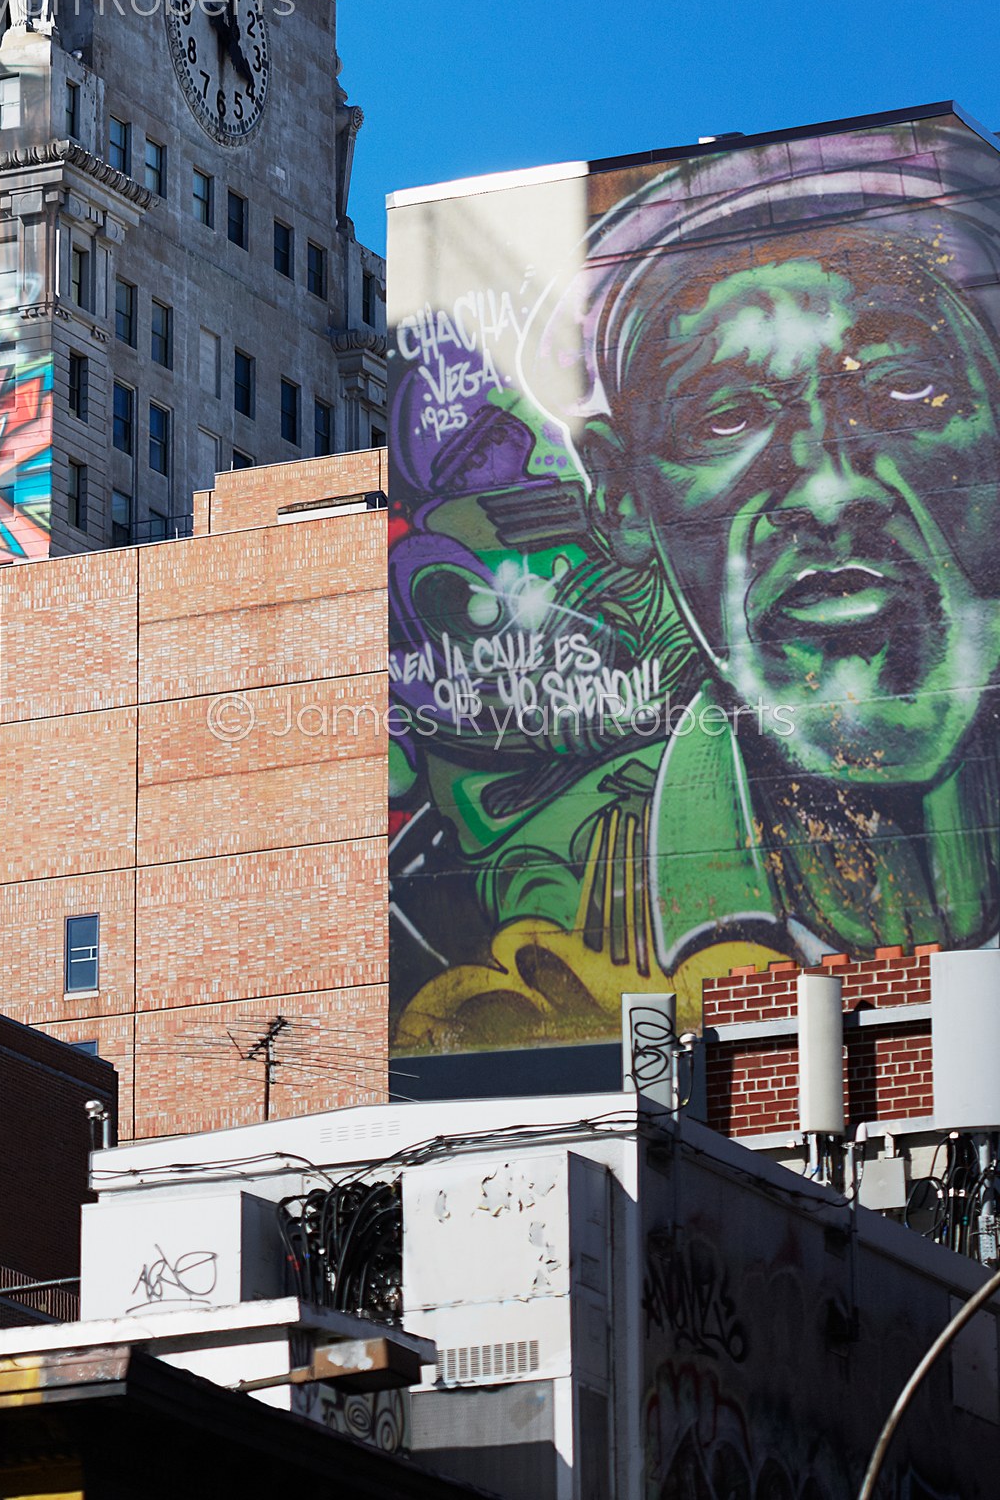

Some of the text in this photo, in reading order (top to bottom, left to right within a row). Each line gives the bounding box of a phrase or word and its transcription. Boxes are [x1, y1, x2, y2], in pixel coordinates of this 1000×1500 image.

[182, 0, 192, 26] 9
[247, 11, 256, 38] 2
[187, 36, 197, 65] 8
[253, 45, 262, 73] 3
[200, 70, 211, 99] 7
[217, 89, 226, 117] 6
[234, 91, 244, 120] 5
[473, 630, 545, 673] CALLE
[554, 633, 601, 672] ES
